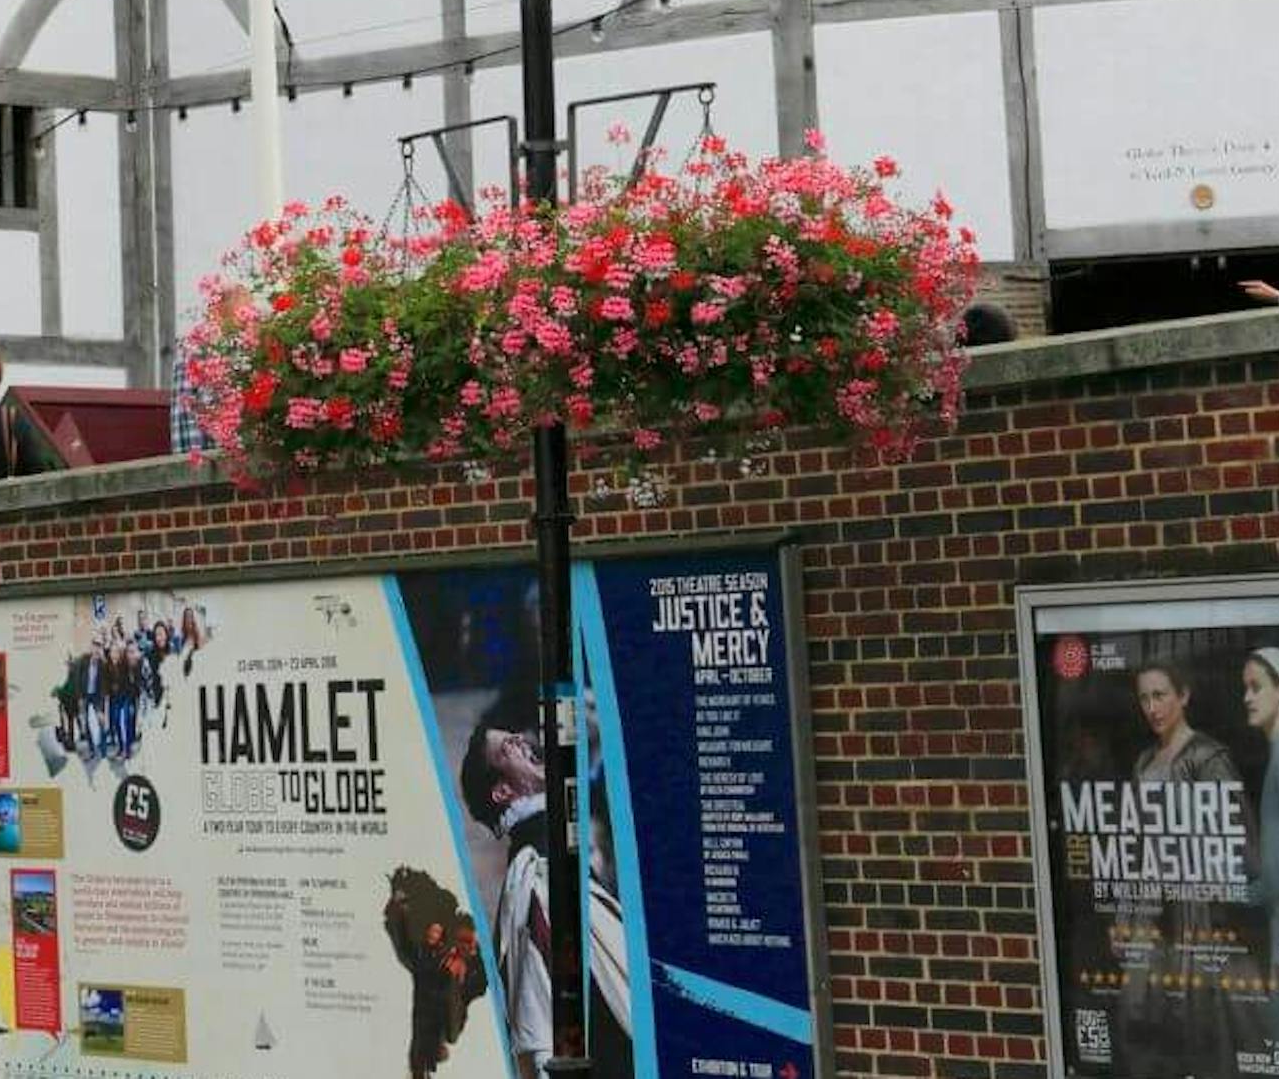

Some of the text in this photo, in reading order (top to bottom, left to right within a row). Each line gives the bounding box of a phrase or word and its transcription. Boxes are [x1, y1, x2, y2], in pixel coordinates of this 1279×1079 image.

[677, 574, 721, 594] THEATRE
[724, 572, 768, 591] SEASON
[652, 591, 769, 632] JUSTICE &
[691, 628, 770, 667] MERCY
[694, 669, 720, 685] APRIL
[729, 667, 772, 684] OCTOBER
[198, 678, 386, 764] HAMLET
[124, 783, 151, 821] £5
[201, 769, 387, 814] GLOBE TO GLOBE
[1060, 779, 1247, 835] MEASURE
[1067, 834, 1091, 880] FOR
[1090, 834, 1248, 883] MEASURE
[1094, 881, 1251, 903] BY WILLIAM SHAKESPEARE
